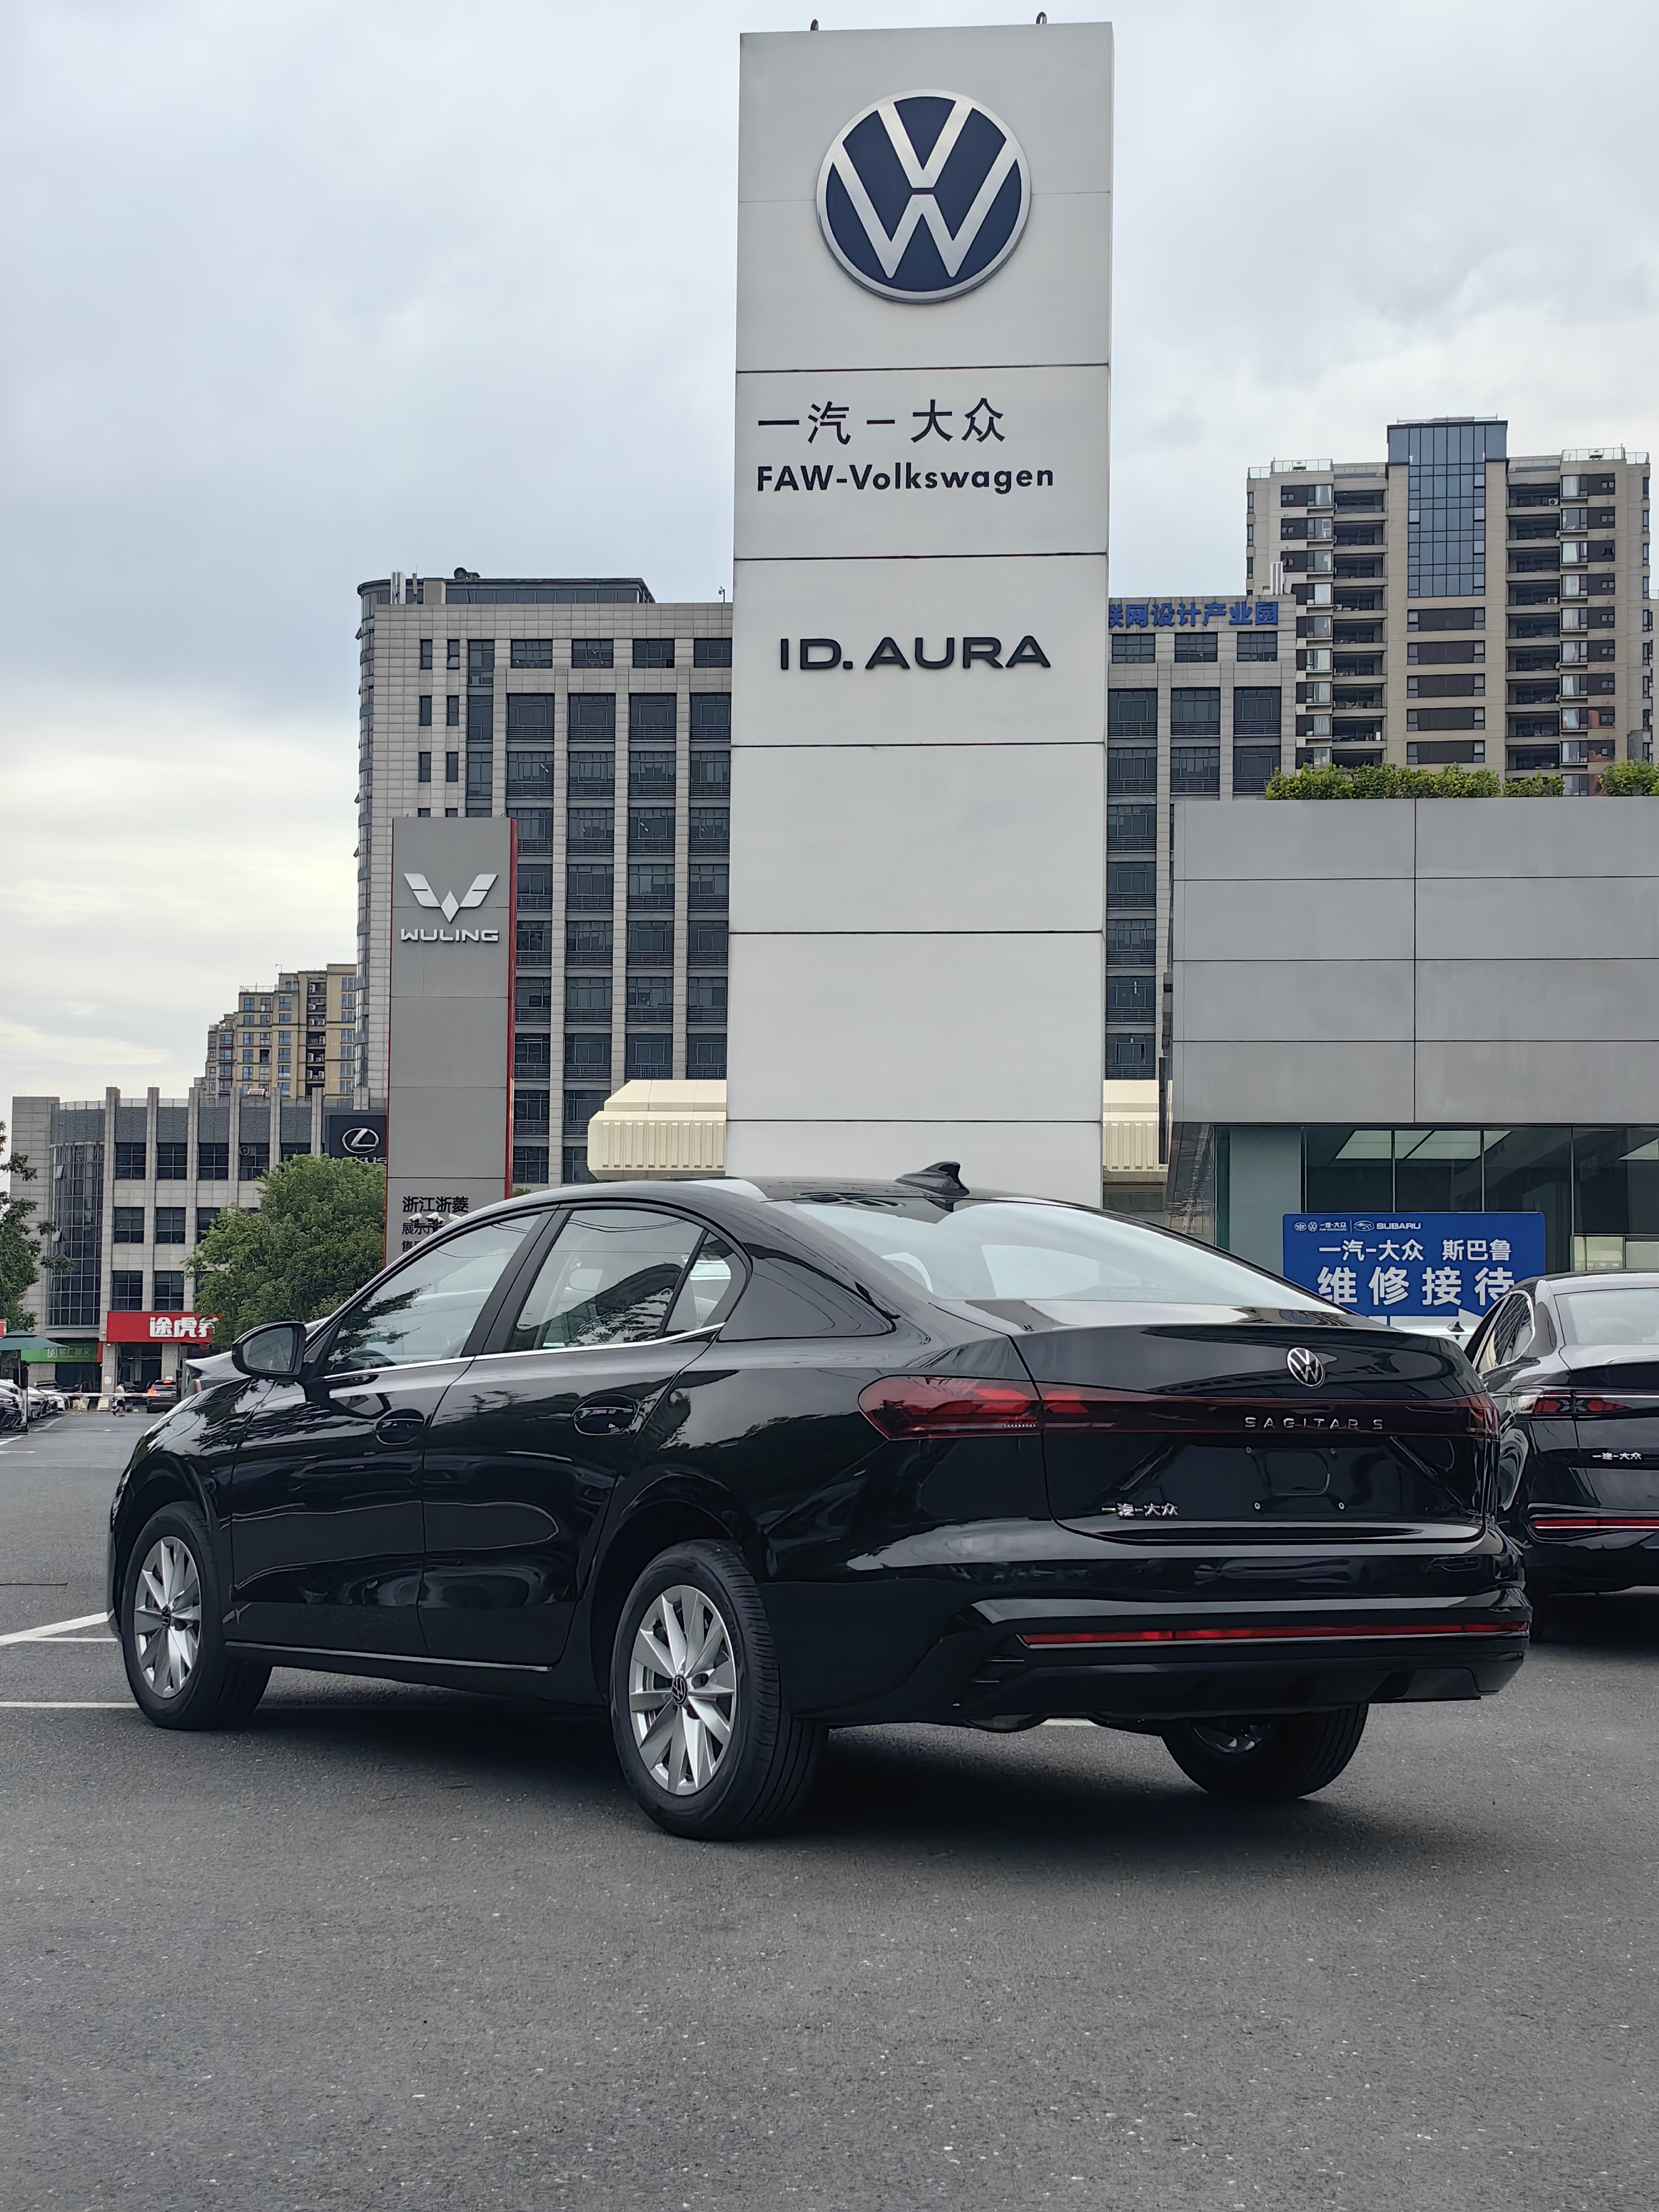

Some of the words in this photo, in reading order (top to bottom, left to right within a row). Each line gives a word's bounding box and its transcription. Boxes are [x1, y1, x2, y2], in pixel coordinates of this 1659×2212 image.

[757, 462, 1053, 494] FAW-Volkswagen
[401, 928, 499, 942] WULING
[402, 1196, 469, 1213] 浙江浙菱
[1442, 1239, 1511, 1261] 斯巴鲁
[1317, 1266, 1515, 1306] 维修接待
